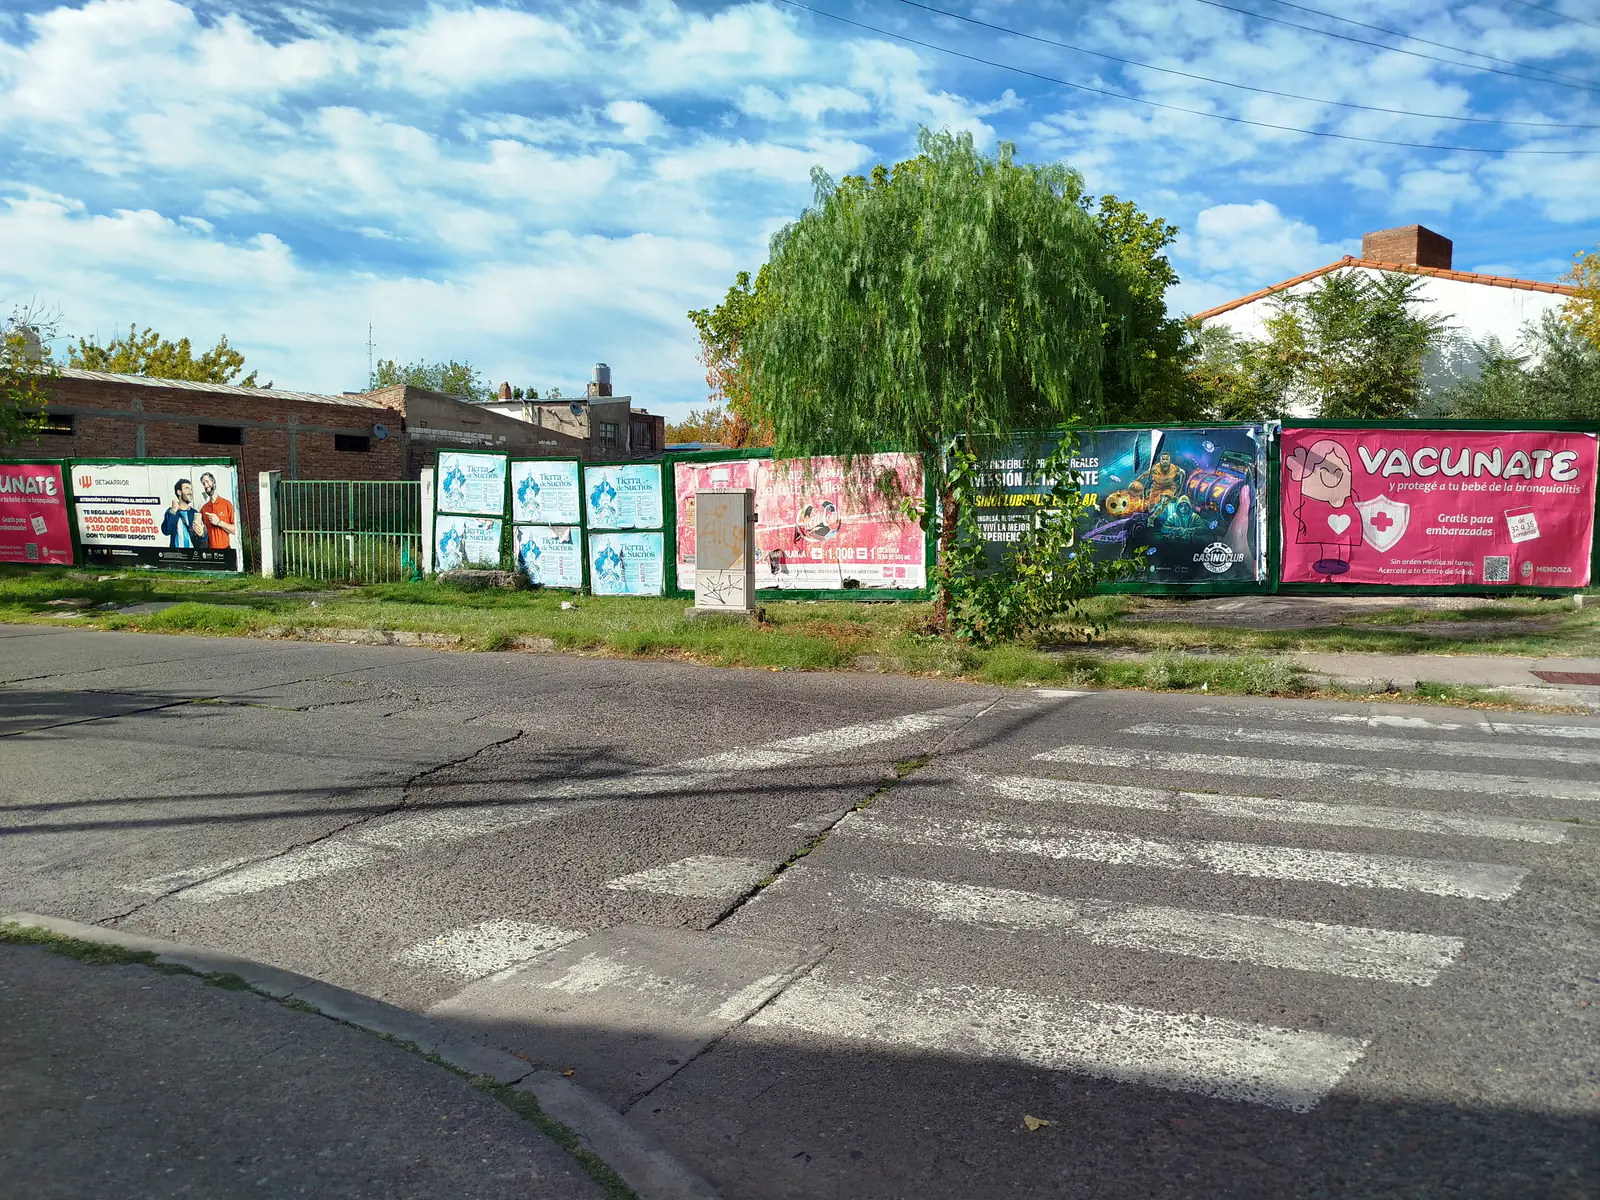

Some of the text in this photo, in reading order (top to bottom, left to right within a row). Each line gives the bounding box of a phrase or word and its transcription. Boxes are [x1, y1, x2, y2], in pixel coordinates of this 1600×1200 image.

[1071, 458, 1098, 468] REALES
[1357, 446, 1579, 482] VACUNATE
[1397, 482, 1437, 492] protegé
[1448, 482, 1459, 490] tu
[1462, 482, 1486, 491] bebé
[1489, 482, 1501, 491] de
[1504, 483, 1513, 492] la
[1438, 514, 1493, 525] Gratis para
[998, 523, 1006, 531] LA
[1008, 523, 1030, 531] MEJOR
[1426, 527, 1493, 536] embarazadas
[1511, 525, 1519, 534] 32
[1527, 521, 1534, 530] 36
[1192, 553, 1244, 562] CASINOCLUB
